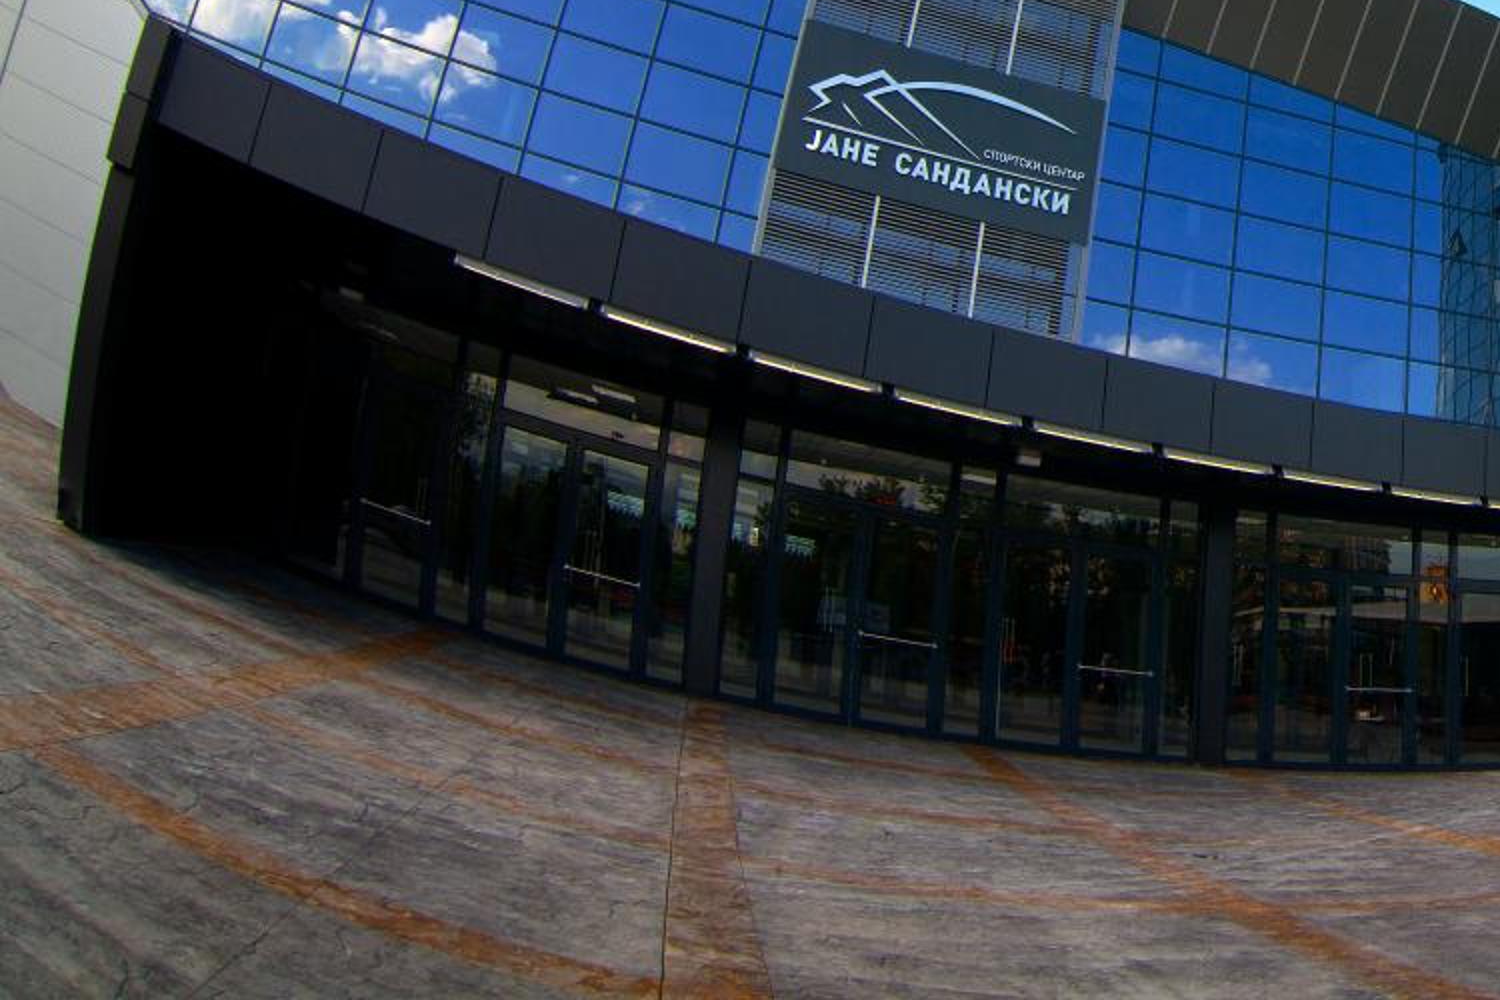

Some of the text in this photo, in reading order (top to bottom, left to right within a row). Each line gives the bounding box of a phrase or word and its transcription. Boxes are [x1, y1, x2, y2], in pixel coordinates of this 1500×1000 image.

[804, 129, 1072, 215] ЈАНЕ САНДАНСКИ
[983, 149, 1086, 181] СПОРТСКИ ЦЕНТАР
